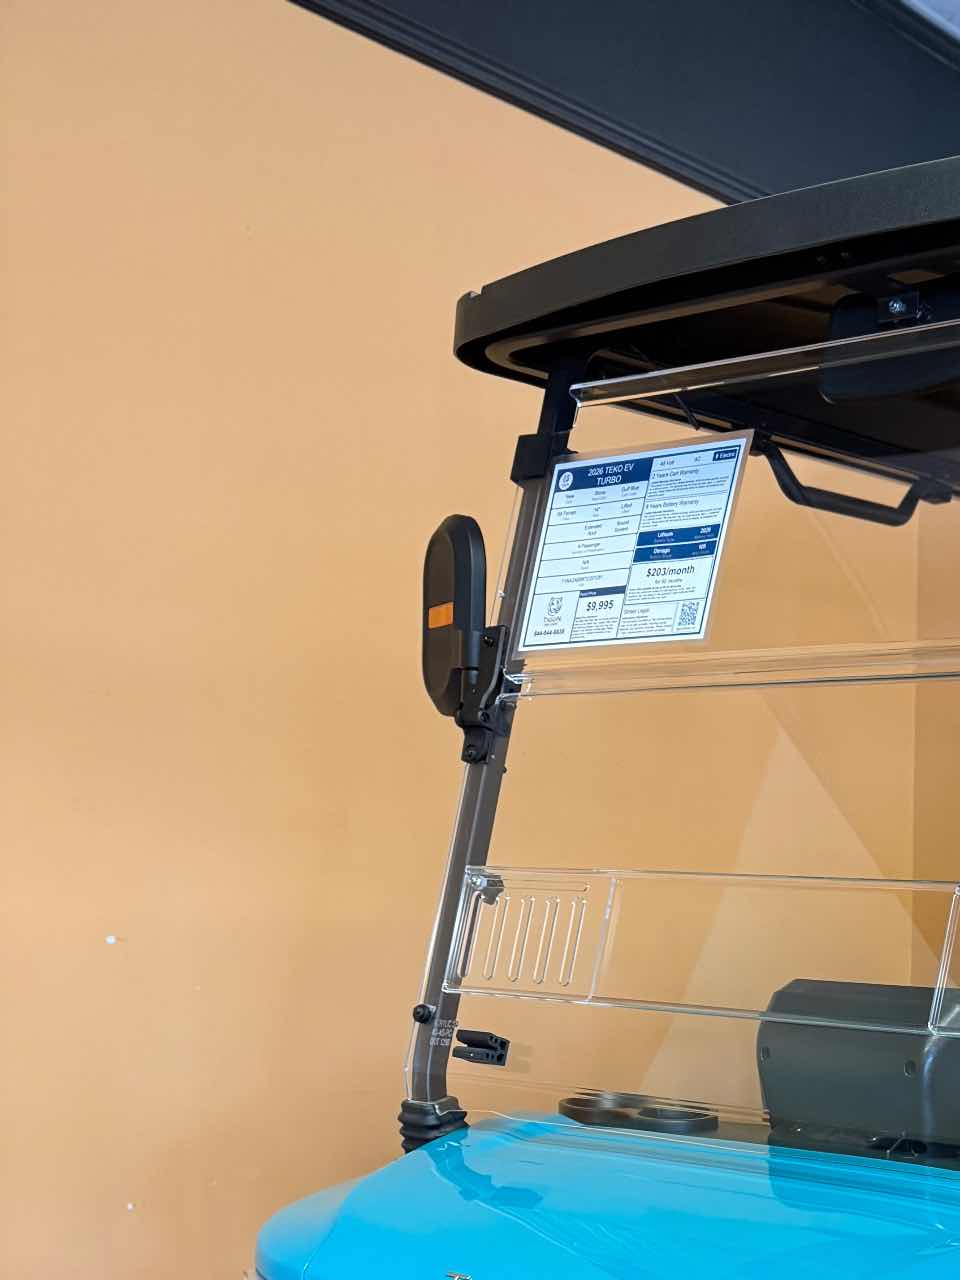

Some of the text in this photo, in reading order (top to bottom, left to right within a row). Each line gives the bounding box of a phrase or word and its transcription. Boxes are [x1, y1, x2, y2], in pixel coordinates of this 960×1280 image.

[587, 463, 634, 476] 2026 TEKO EV
[597, 475, 622, 485] TURBO
[646, 564, 696, 578] $203/month
[586, 600, 615, 612] $9,995
